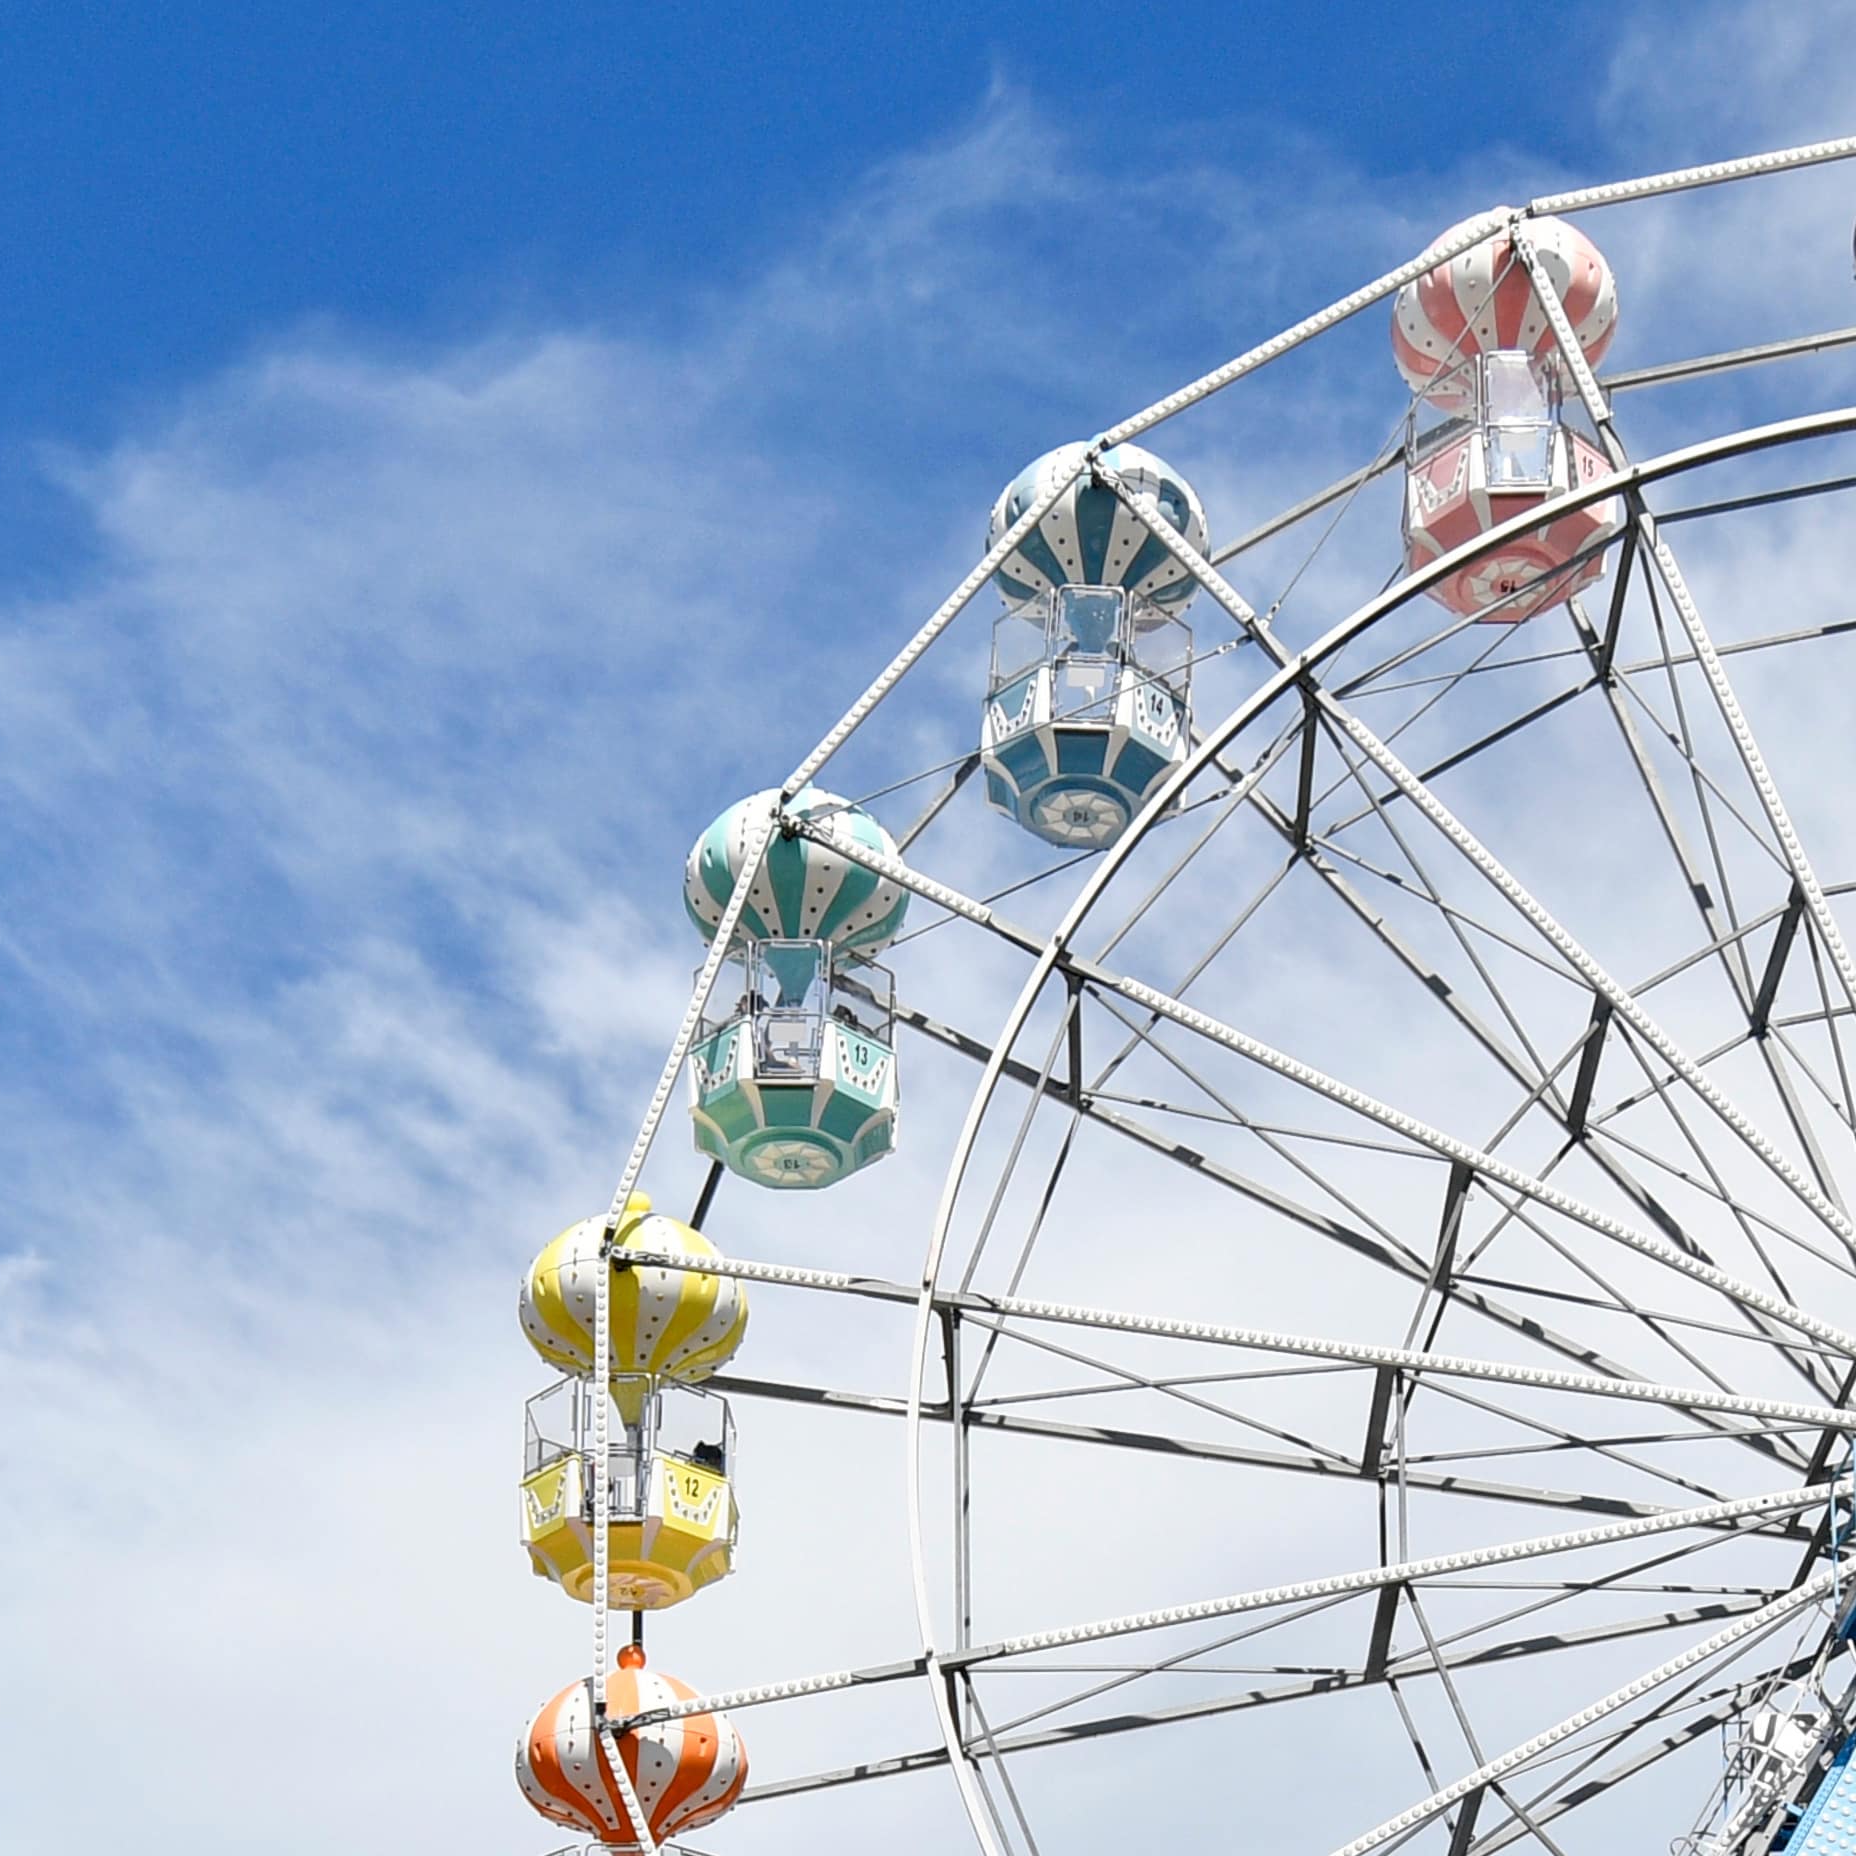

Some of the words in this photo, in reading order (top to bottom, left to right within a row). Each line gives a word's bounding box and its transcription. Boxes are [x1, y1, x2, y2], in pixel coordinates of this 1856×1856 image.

[1582, 455, 1594, 477] 15
[1150, 694, 1164, 715] 14
[853, 1043, 869, 1066] 13
[684, 1475, 699, 1497] 12
